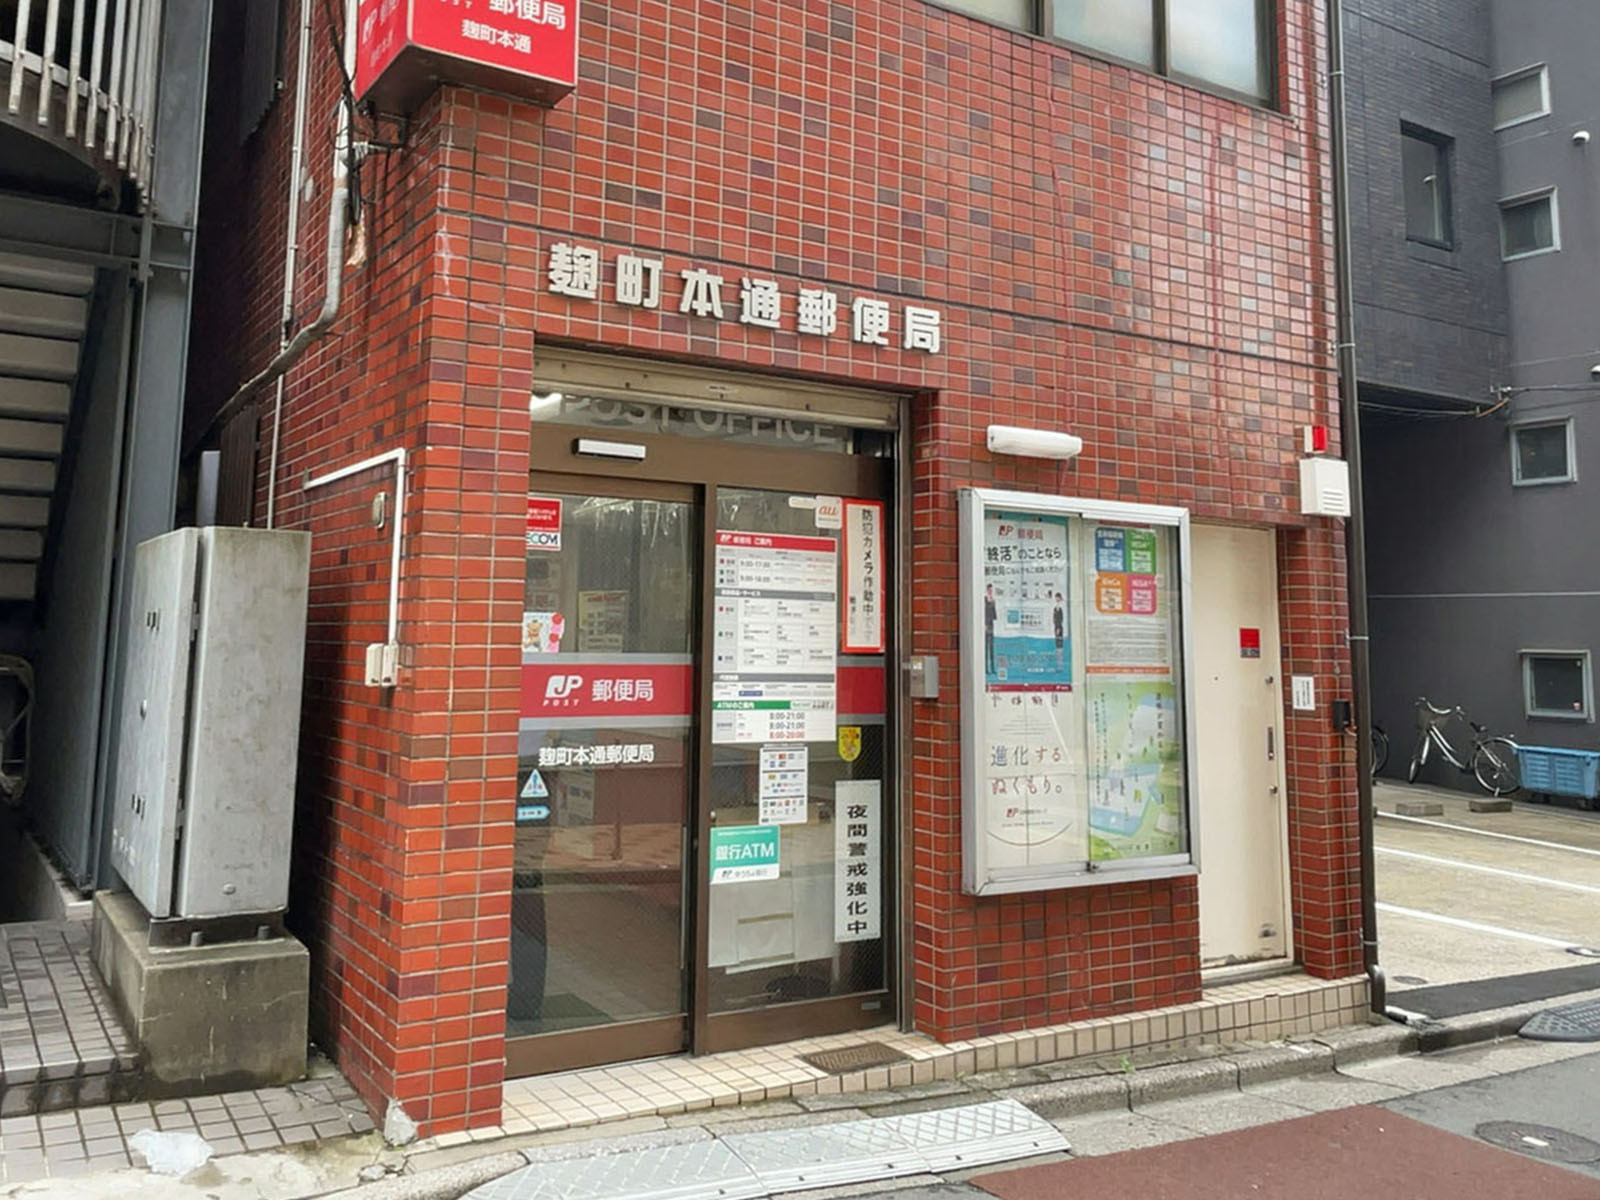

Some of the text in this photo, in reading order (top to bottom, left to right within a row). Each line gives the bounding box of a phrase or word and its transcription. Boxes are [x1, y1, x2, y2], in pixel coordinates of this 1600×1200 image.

[461, 18, 532, 54] 麹町本通
[547, 241, 942, 355] 麹町本通郵便局
[591, 680, 654, 702] 郵便局
[846, 803, 868, 935] 夜間警戒強化中
